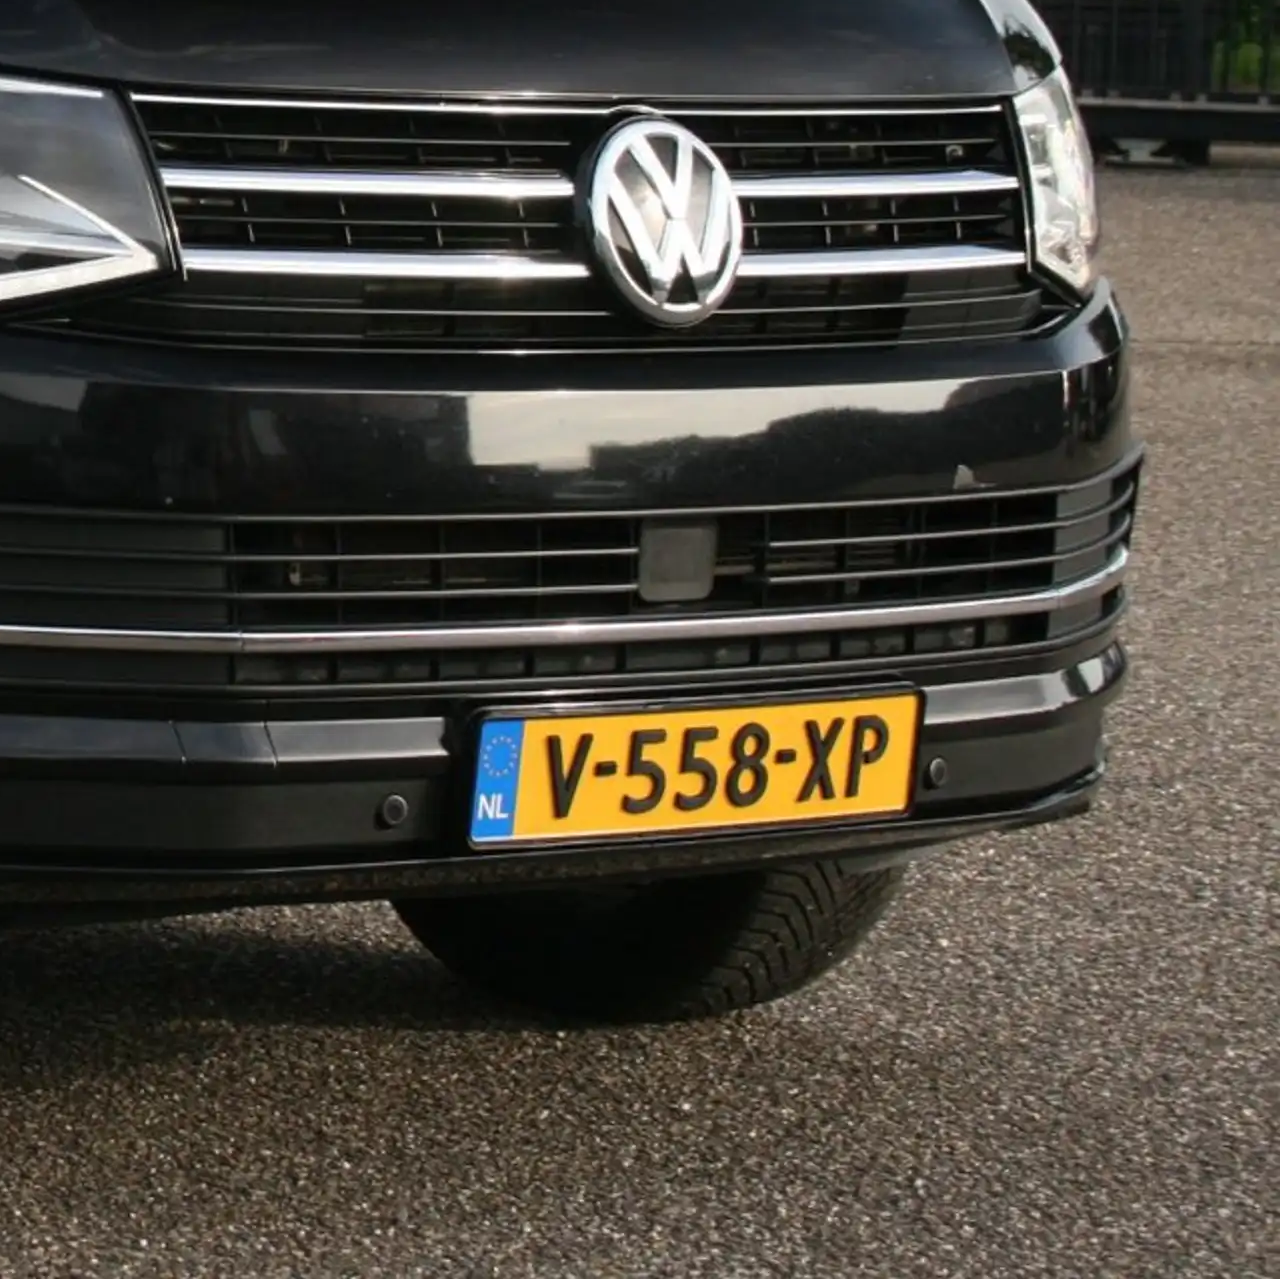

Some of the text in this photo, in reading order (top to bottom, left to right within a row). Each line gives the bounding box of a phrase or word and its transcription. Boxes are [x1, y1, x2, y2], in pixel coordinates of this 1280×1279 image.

[591, 118, 744, 328] VW
[477, 793, 510, 820] NL
[545, 714, 890, 819] V-558-XP
